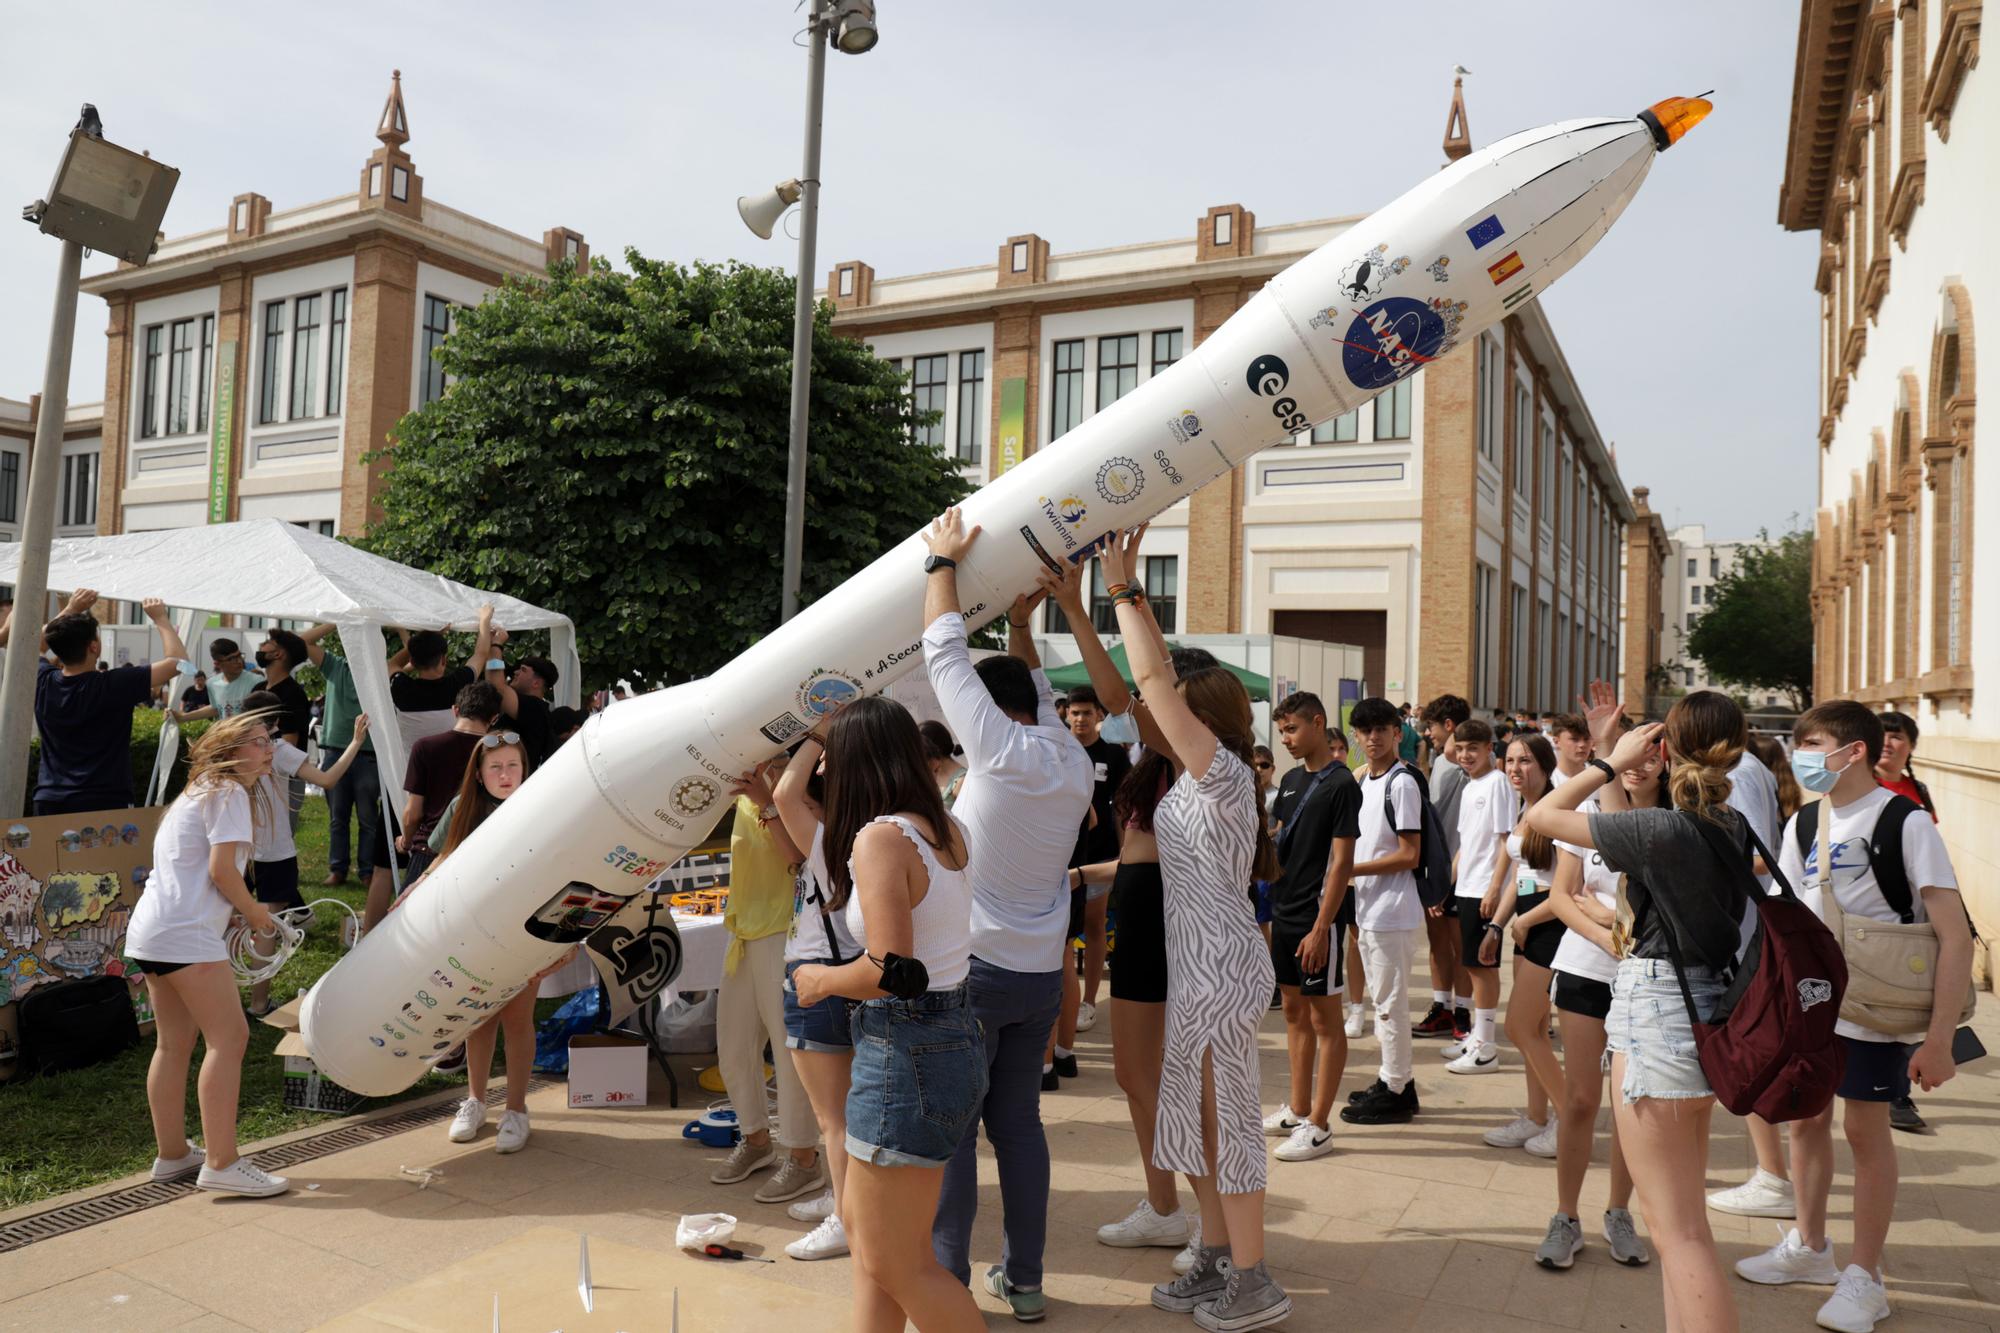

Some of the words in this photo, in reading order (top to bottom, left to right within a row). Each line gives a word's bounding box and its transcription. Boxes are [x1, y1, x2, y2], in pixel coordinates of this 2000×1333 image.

[1366, 307, 1415, 378] NASA
[214, 364, 232, 522] EMPRENDIMIENTO
[686, 743, 702, 760] IES
[700, 758, 721, 776] LOS
[604, 851, 661, 878] STEAM
